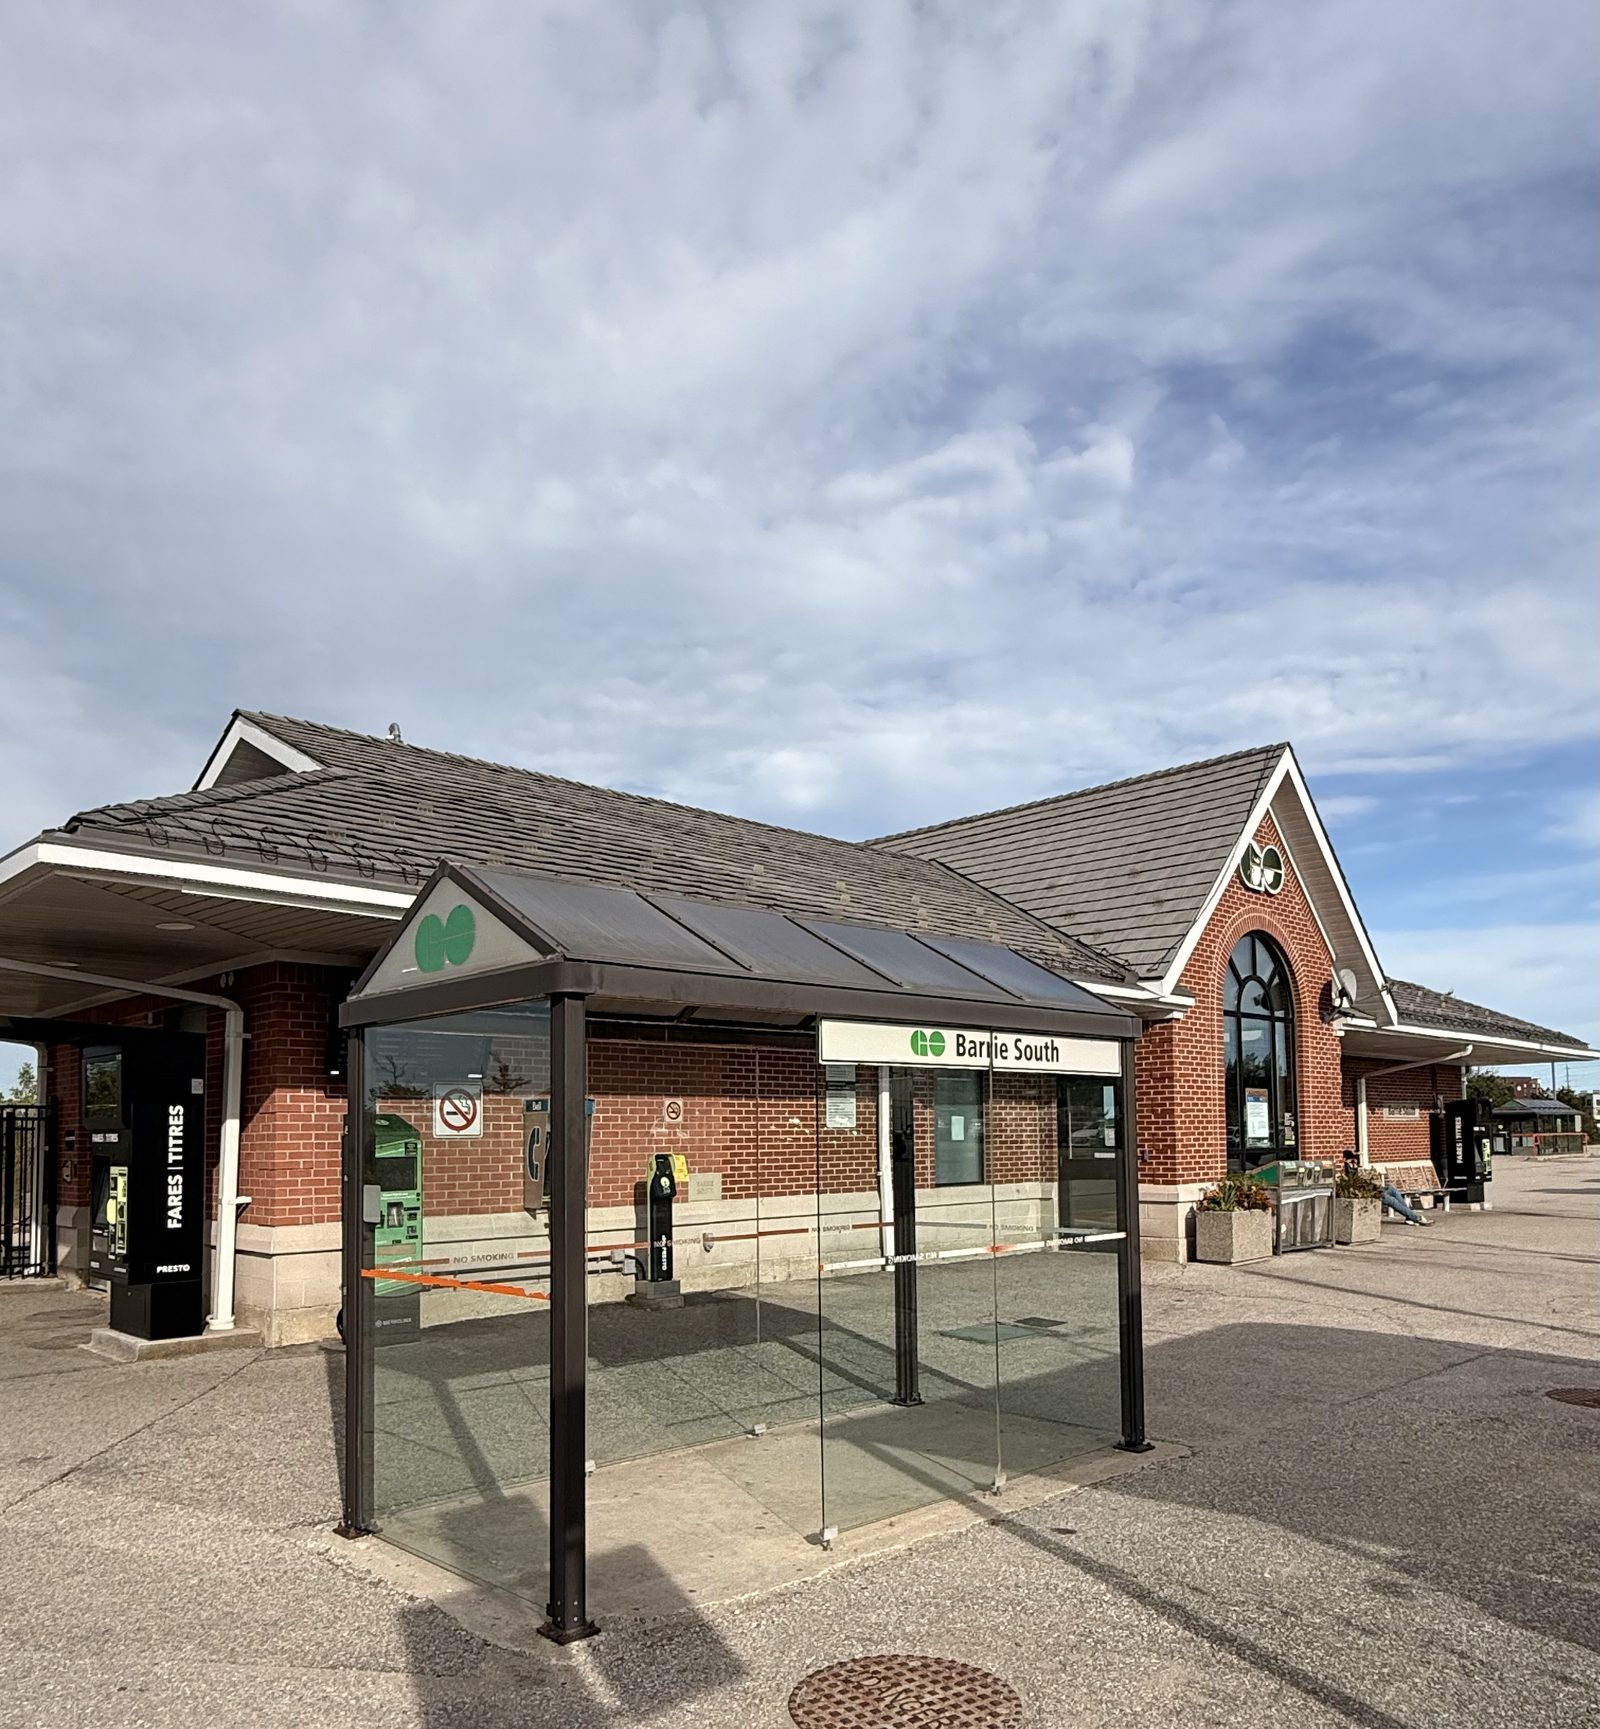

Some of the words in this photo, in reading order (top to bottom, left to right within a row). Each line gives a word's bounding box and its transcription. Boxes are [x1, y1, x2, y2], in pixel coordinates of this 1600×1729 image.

[956, 1033, 1009, 1060] Barrie
[1014, 1038, 1060, 1063] South
[168, 1104, 184, 1163] TITRES
[167, 1174, 183, 1229] FARES
[156, 1264, 191, 1274] PRESTO
[453, 1256, 468, 1264] NO
[470, 1252, 514, 1263] SMOKING
